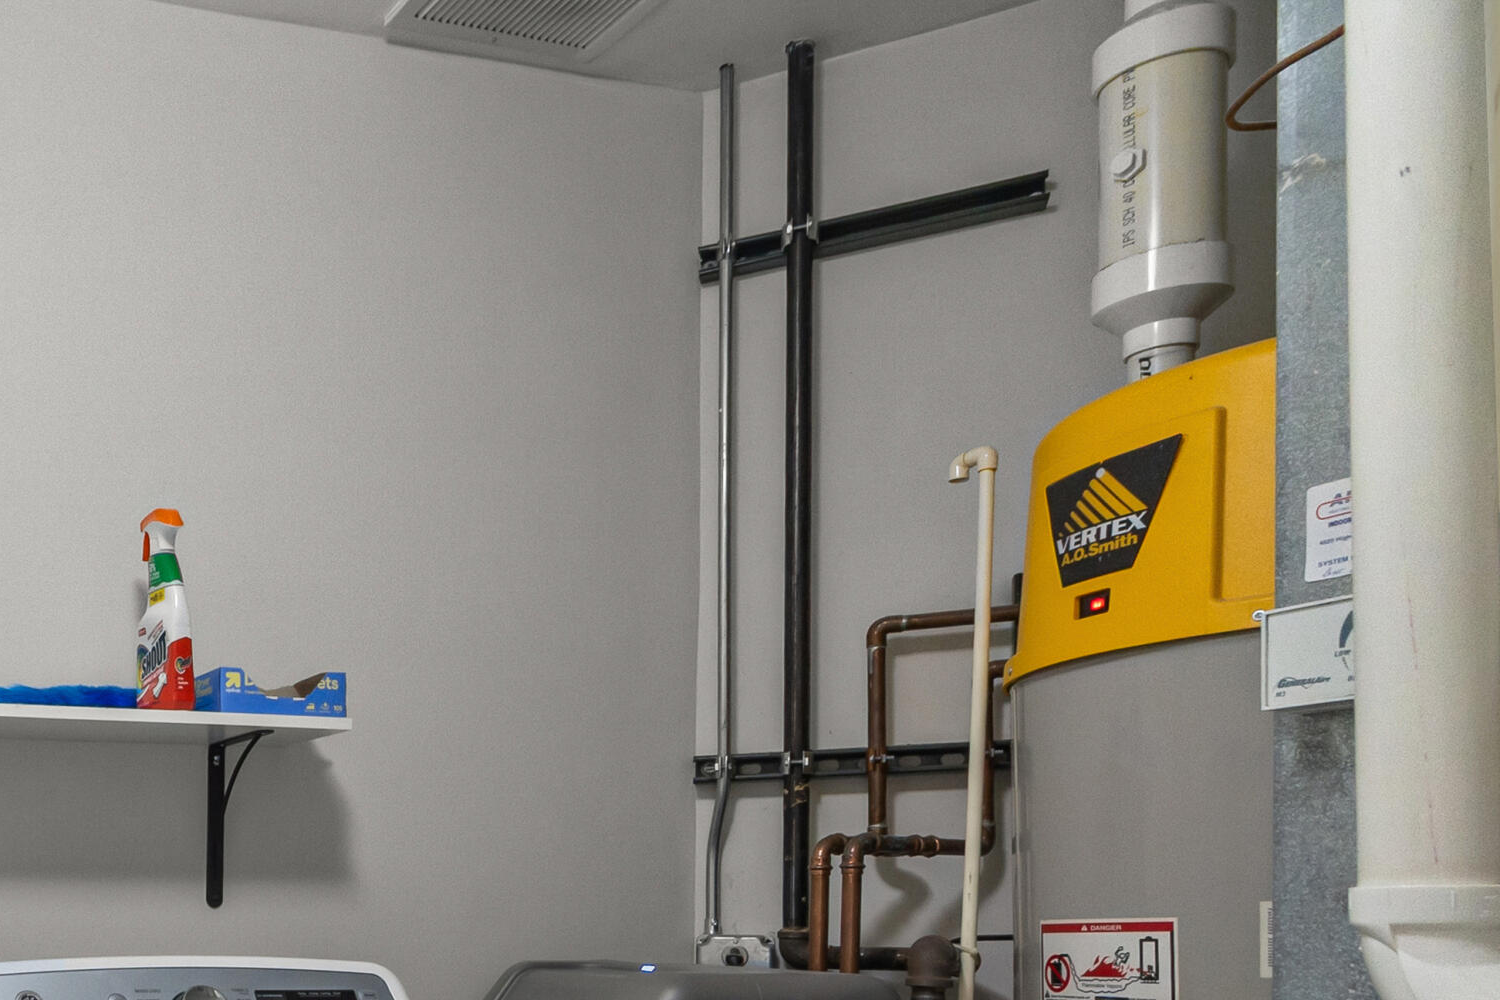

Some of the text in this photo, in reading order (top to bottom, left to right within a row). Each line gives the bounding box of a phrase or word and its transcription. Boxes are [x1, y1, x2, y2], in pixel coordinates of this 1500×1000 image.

[1122, 112, 1136, 188] CLLULAR
[1122, 206, 1136, 226] SCH
[1056, 510, 1149, 555] VERTEX
[1317, 556, 1349, 568] SYSTEM
[141, 629, 167, 680] SHOUT
[317, 677, 339, 690] ets
